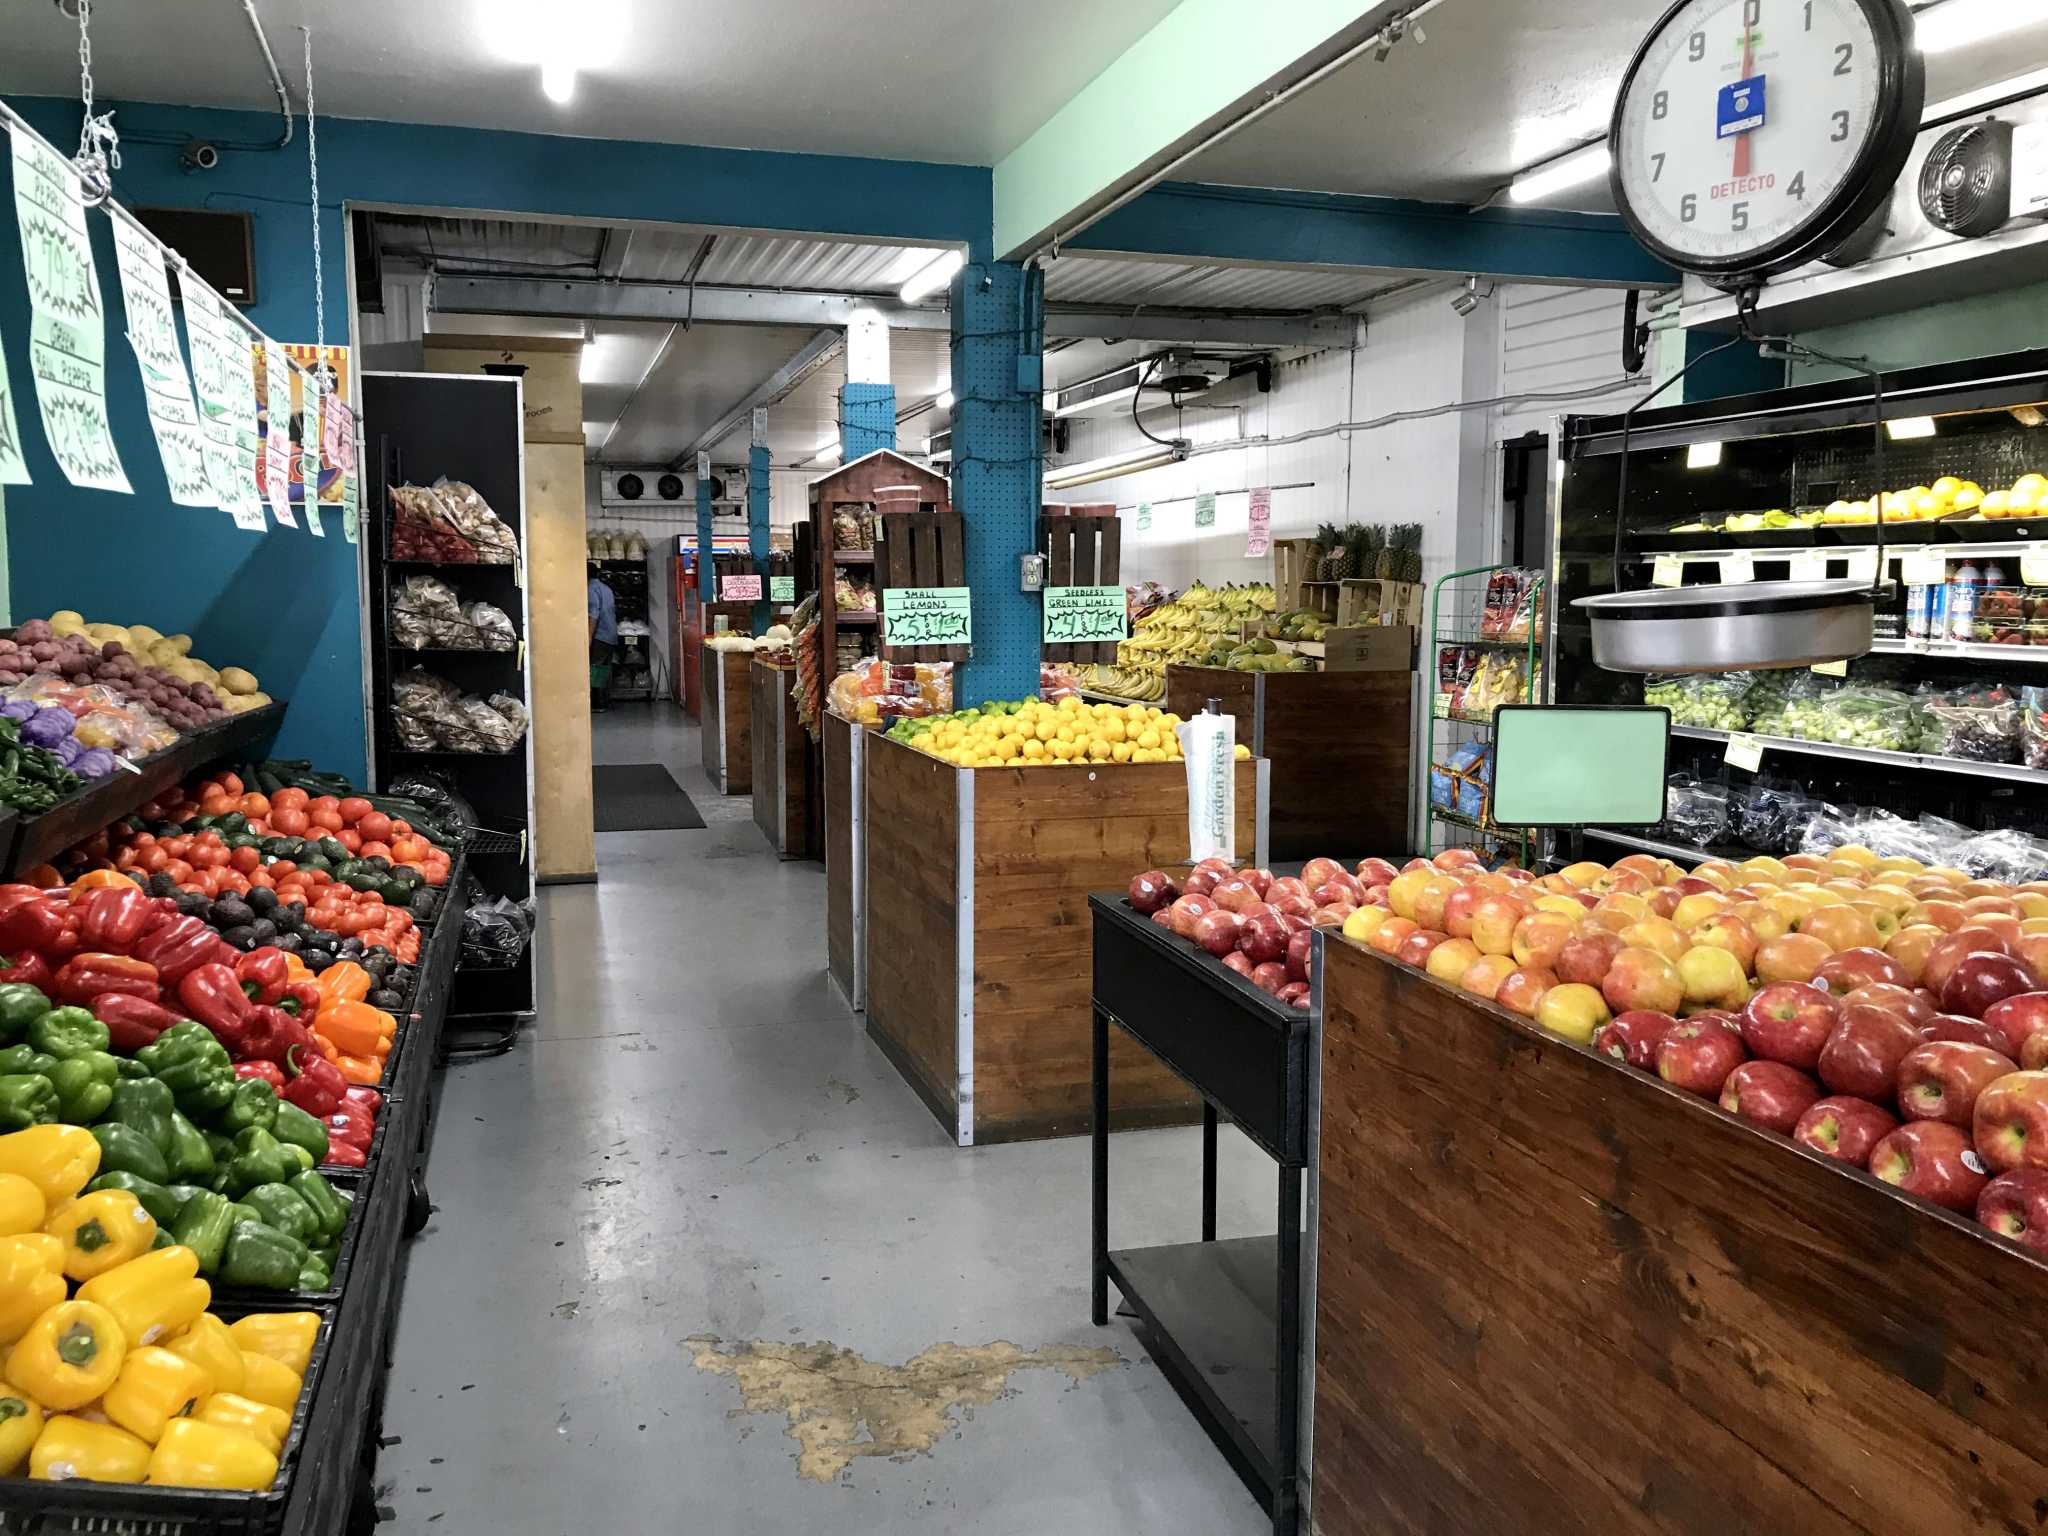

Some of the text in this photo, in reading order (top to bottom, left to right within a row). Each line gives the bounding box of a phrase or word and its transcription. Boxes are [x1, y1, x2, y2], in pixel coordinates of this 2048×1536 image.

[1743, 0, 1760, 27] 0
[1803, 1, 1813, 31] 1
[1688, 31, 1706, 62] 9
[1833, 43, 1853, 76] 2
[1652, 90, 1669, 120] 8
[1830, 110, 1850, 142] 3
[1651, 152, 1666, 183] 7
[1710, 173, 1776, 200] DETECTO
[1786, 170, 1806, 200] 4
[1680, 193, 1697, 223] 6
[1731, 201, 1750, 232] 5
[903, 600, 948, 610] LEMONS
[904, 590, 937, 599] SMALL
[1048, 598, 1114, 608] GREEN LIMES
[1064, 589, 1105, 597] SEEDLESS
[908, 619, 921, 636] 5
[1063, 615, 1076, 633] 4
[1211, 730, 1225, 838] Garden Fresh
